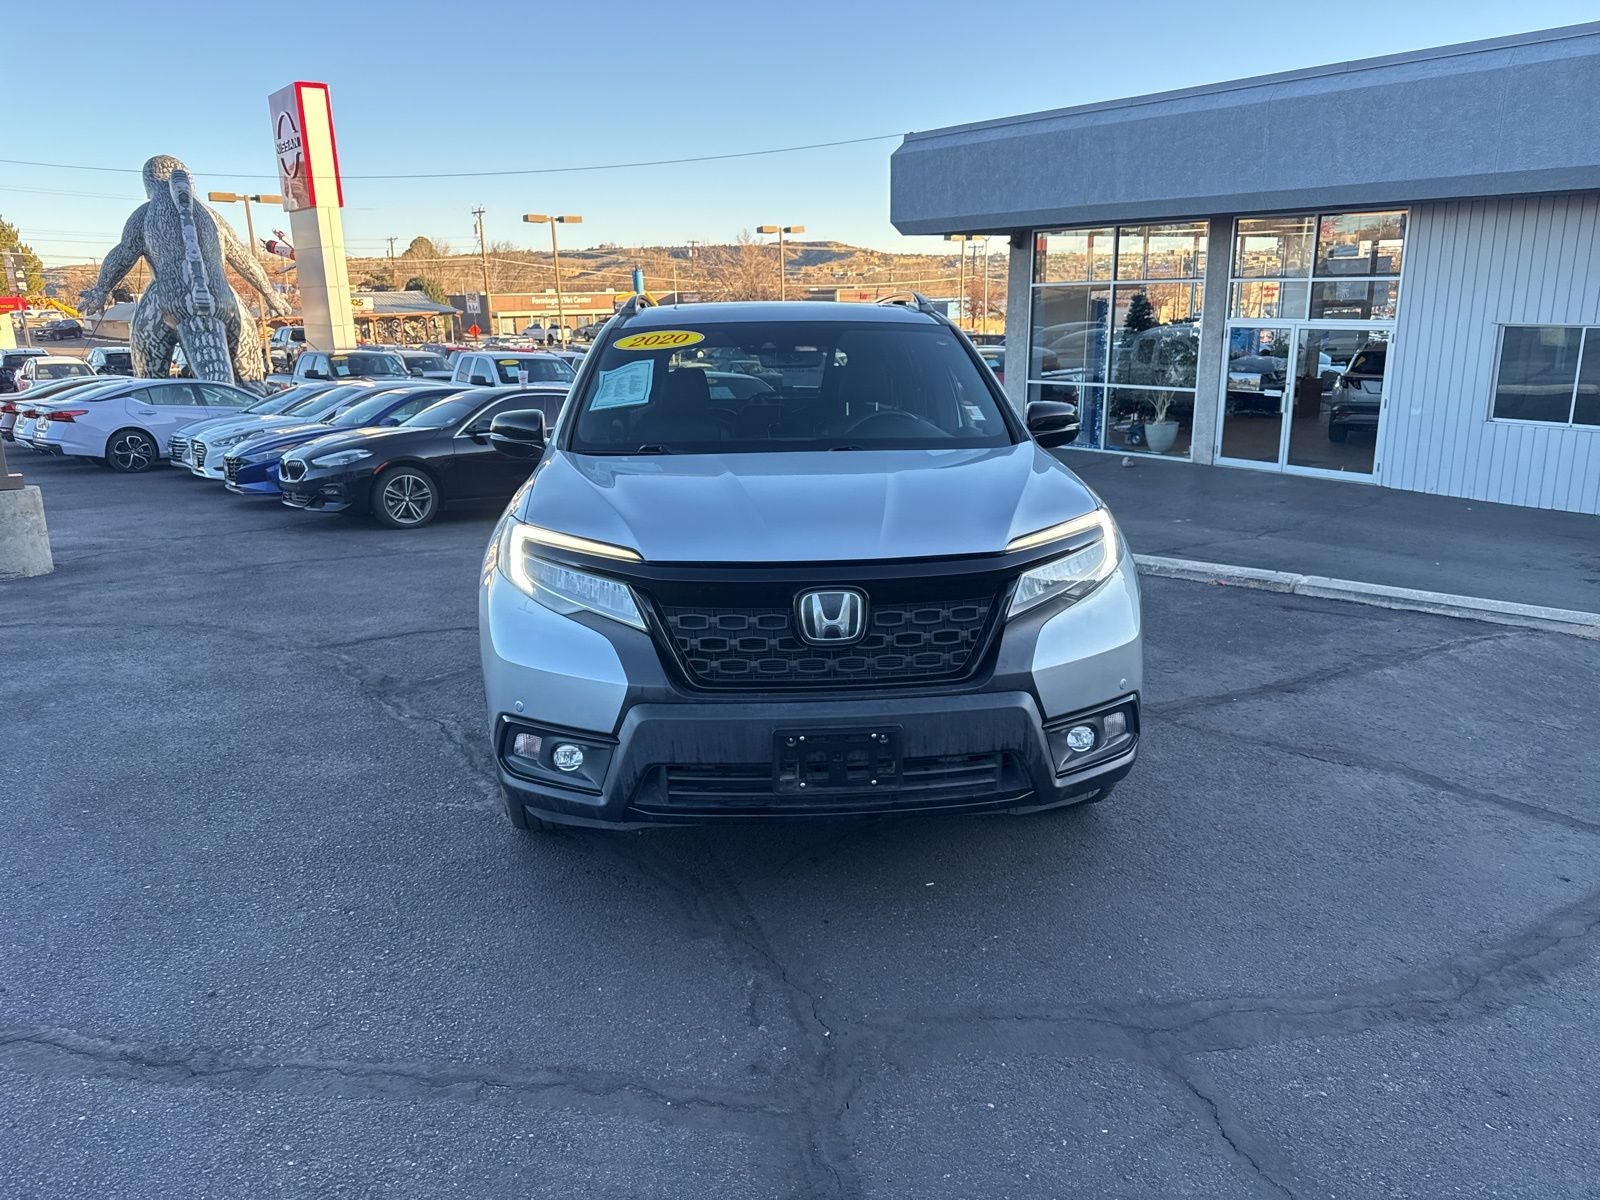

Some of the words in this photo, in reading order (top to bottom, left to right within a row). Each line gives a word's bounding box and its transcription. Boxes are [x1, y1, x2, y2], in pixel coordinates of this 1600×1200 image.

[276, 137, 301, 154] NISSAN
[531, 297, 564, 305] Farmingtn
[628, 334, 689, 347] 2020
